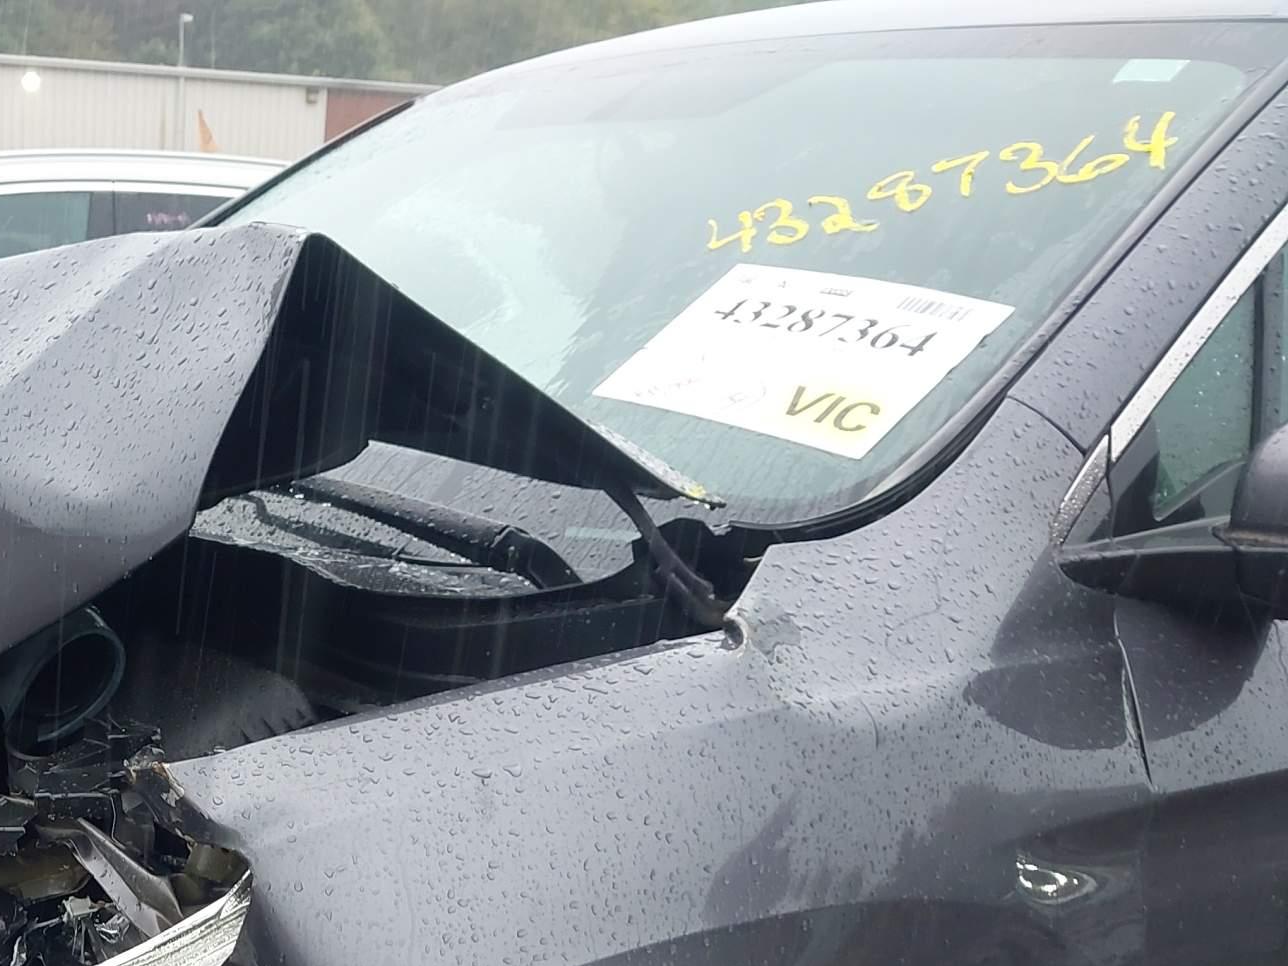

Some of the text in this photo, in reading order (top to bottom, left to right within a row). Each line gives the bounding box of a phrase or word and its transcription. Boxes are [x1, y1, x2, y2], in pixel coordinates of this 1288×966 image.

[707, 111, 1179, 252] 43287364
[714, 299, 938, 357] 43287364
[785, 386, 882, 432] VIC
